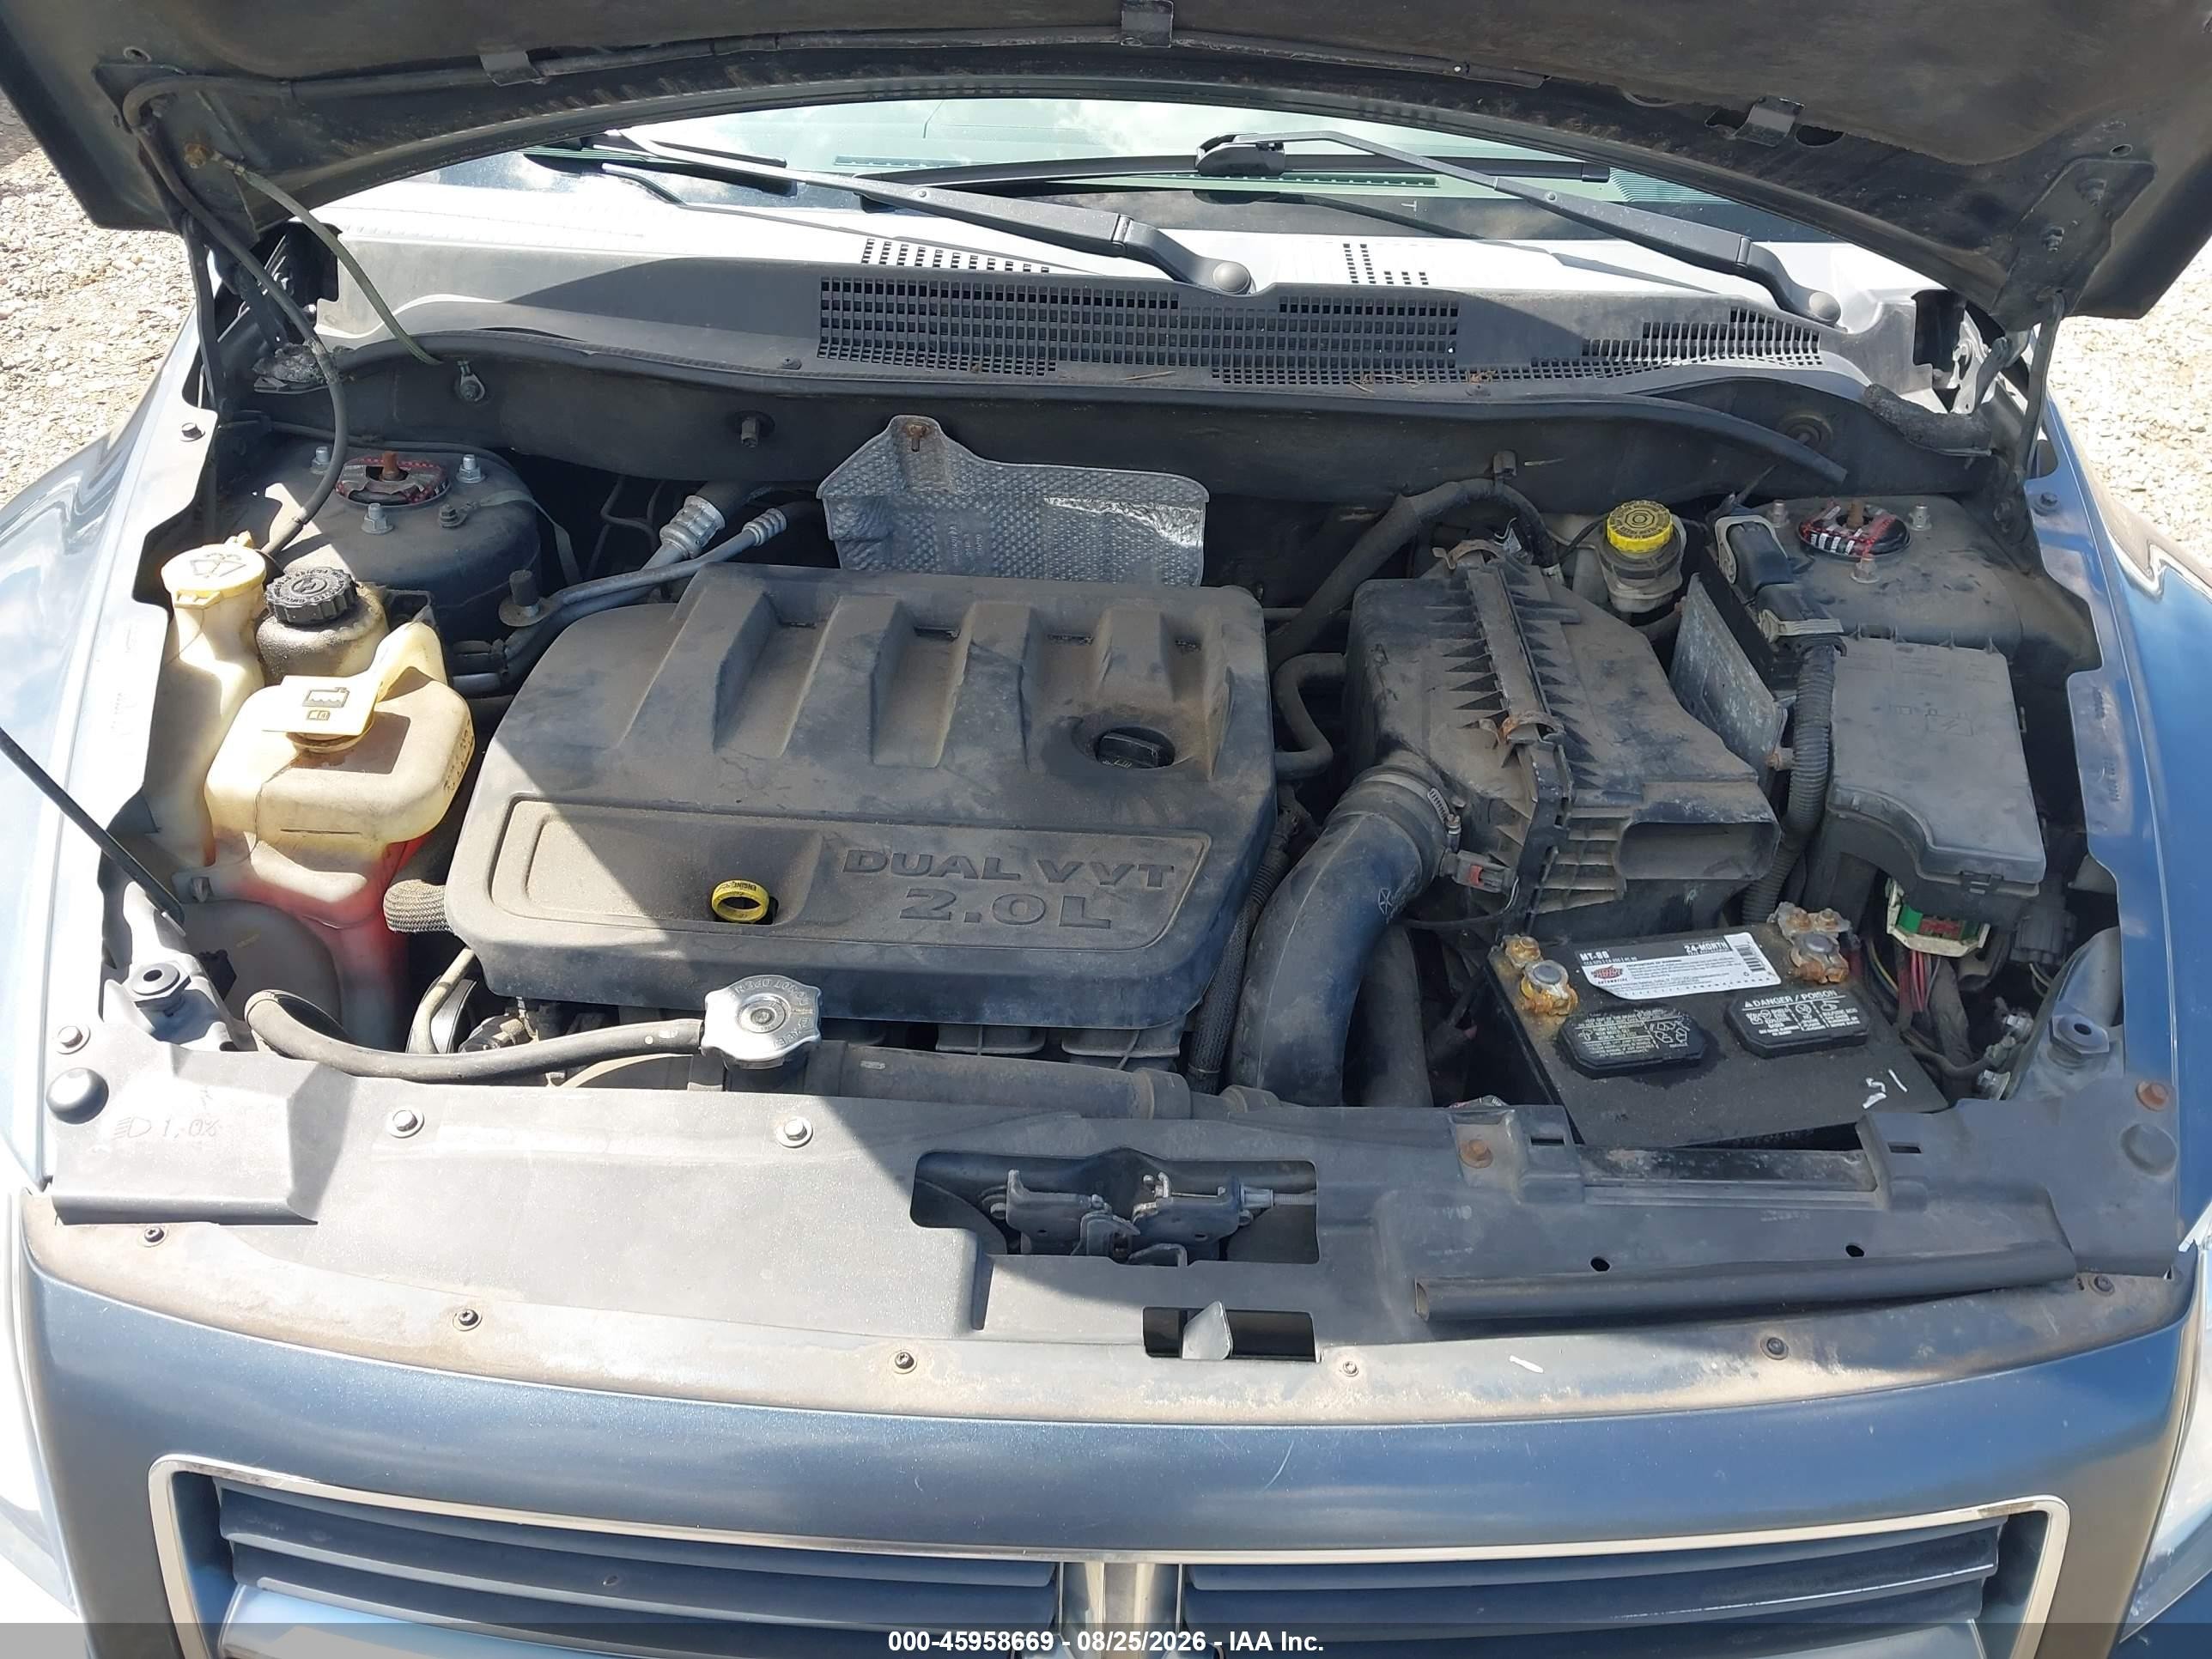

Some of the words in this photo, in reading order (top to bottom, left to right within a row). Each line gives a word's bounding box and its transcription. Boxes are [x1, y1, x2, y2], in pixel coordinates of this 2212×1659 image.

[842, 849, 1022, 880] DUAL
[1036, 860, 1175, 888] VVT
[899, 888, 1112, 929] 2.0L
[1752, 995, 1794, 1007] DANGER
[1800, 989, 1838, 1001] POISON
